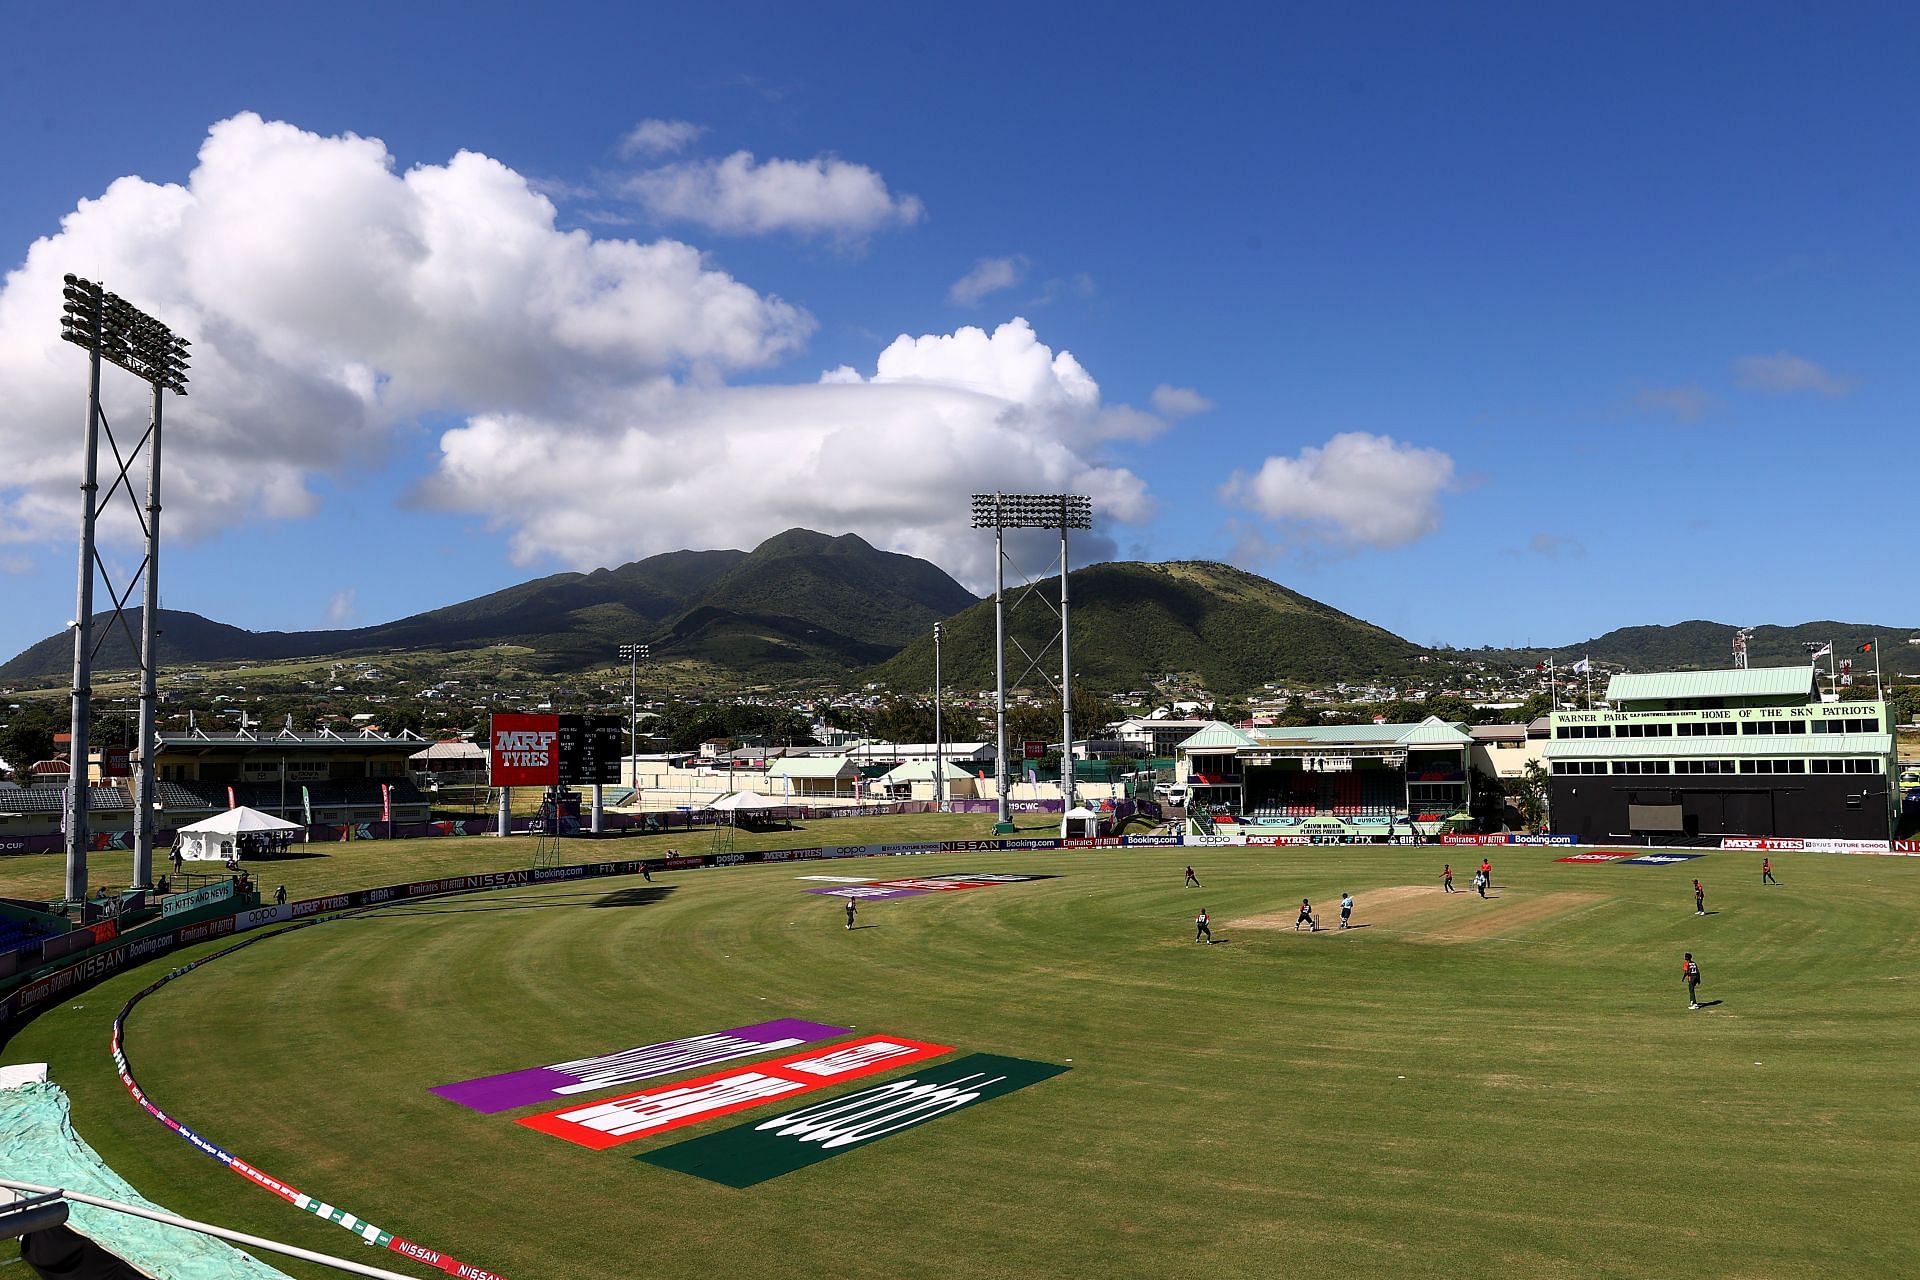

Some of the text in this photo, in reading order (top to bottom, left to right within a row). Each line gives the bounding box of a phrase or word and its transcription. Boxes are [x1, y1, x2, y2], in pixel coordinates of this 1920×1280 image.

[1558, 713, 1629, 722] WARNER PARK
[1702, 705, 1876, 719] HOME OF THE SKN PATRIOTS
[495, 731, 556, 750] MRF
[502, 751, 549, 767] TYRES
[941, 841, 999, 850] NISSAN
[1006, 840, 1055, 848] Booking.com
[1128, 837, 1178, 845] Booking.com
[1444, 835, 1476, 844] Emirates
[1488, 836, 1506, 844] BETTER
[1515, 835, 1571, 845] Booking.com
[1725, 840, 1804, 849] MRF TYRES
[764, 849, 822, 860] MRF TYRES
[837, 846, 866, 855] oppo
[534, 867, 583, 880] Booking.com
[599, 864, 615, 873] FTX
[468, 872, 528, 888] NISSAN
[409, 882, 439, 895] Emirates
[175, 896, 195, 909] KITTS
[195, 892, 210, 904] AND
[210, 886, 229, 898] NEVIS
[293, 896, 349, 916] MRF TYRES
[249, 907, 278, 923] oppo
[181, 925, 208, 942] Emirates
[130, 934, 173, 958] Booking.com
[74, 949, 126, 984] NISSAN
[21, 984, 50, 1007] Emirates
[399, 1241, 441, 1264] NISSAN
